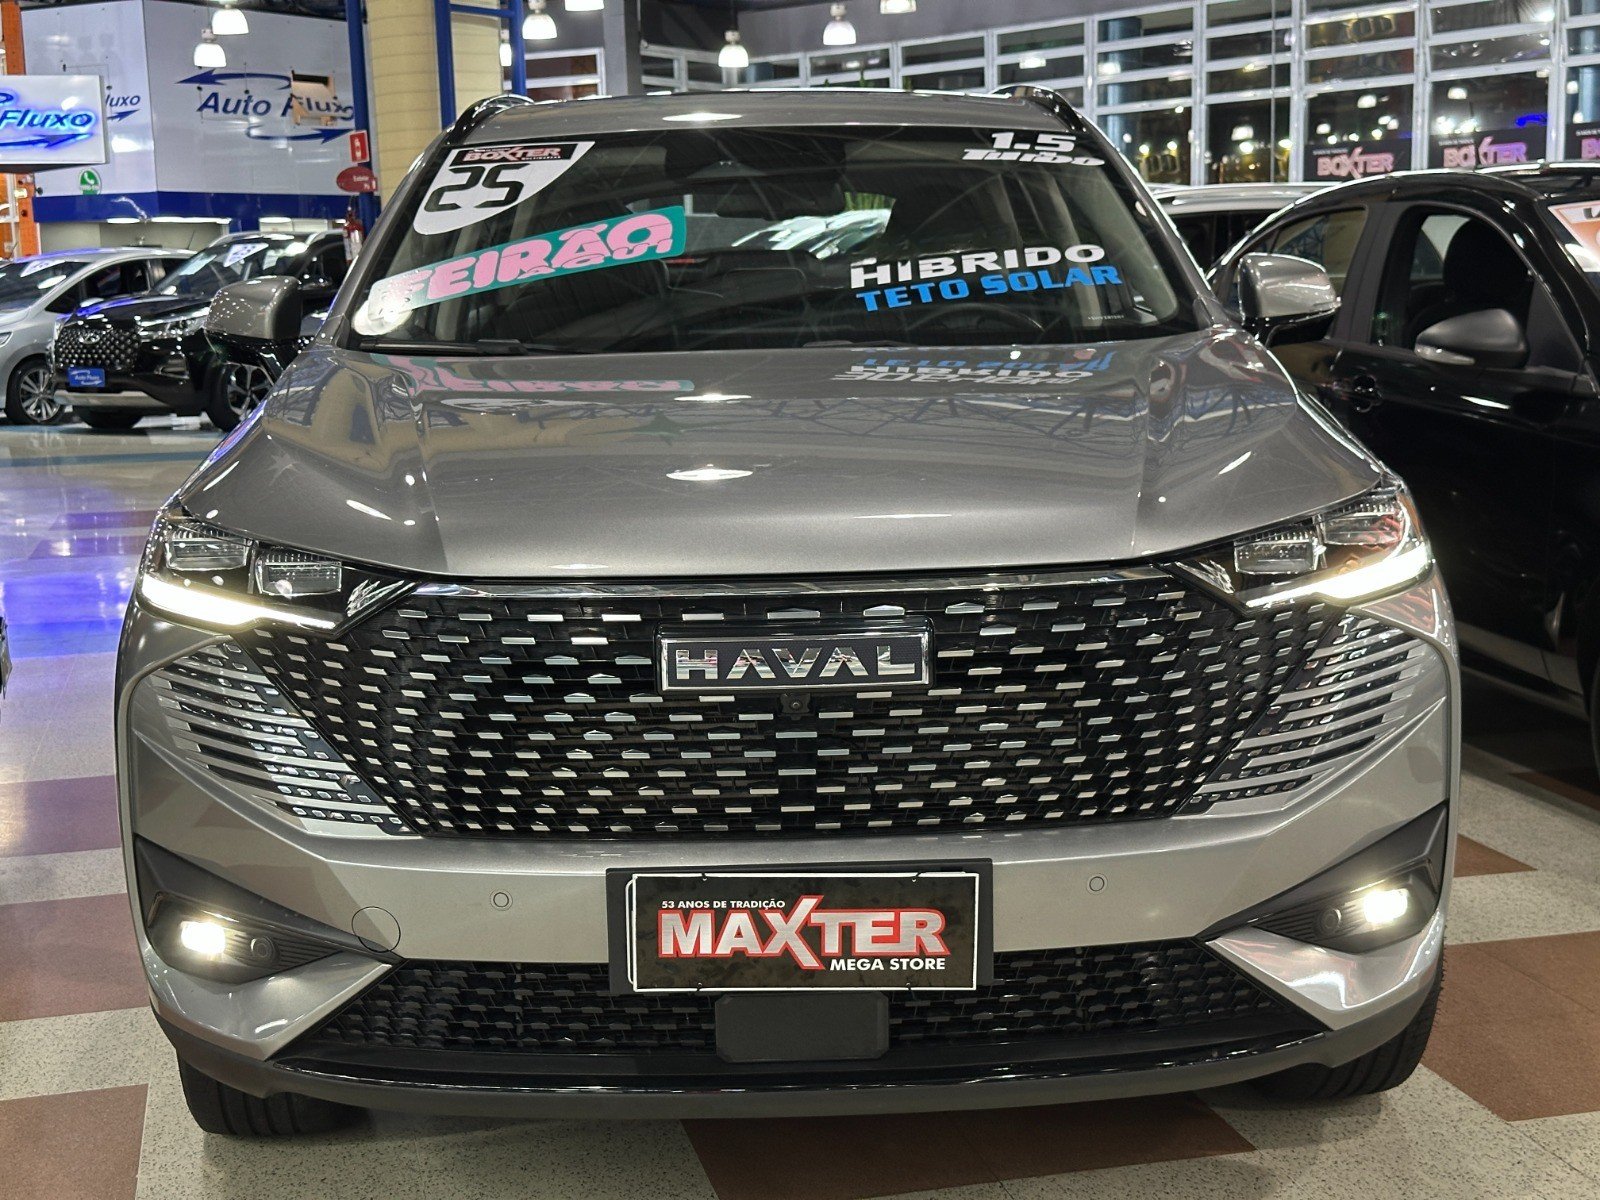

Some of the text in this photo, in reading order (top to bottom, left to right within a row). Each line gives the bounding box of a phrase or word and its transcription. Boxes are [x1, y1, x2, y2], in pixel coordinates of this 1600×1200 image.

[104, 94, 141, 107] luxo
[196, 92, 271, 116] Auto
[0, 109, 94, 128] Fluxo
[991, 131, 1077, 153] 1.5
[462, 146, 562, 162] BOXTER
[1317, 146, 1394, 180] BOXTER
[424, 163, 531, 212] 25
[856, 265, 1122, 312] TETO SOLAR
[675, 646, 916, 680] HAVAL
[730, 899, 786, 910] TRADIÇÃO
[658, 895, 951, 970] MAXTER
[830, 958, 946, 971] MEGA STORE
